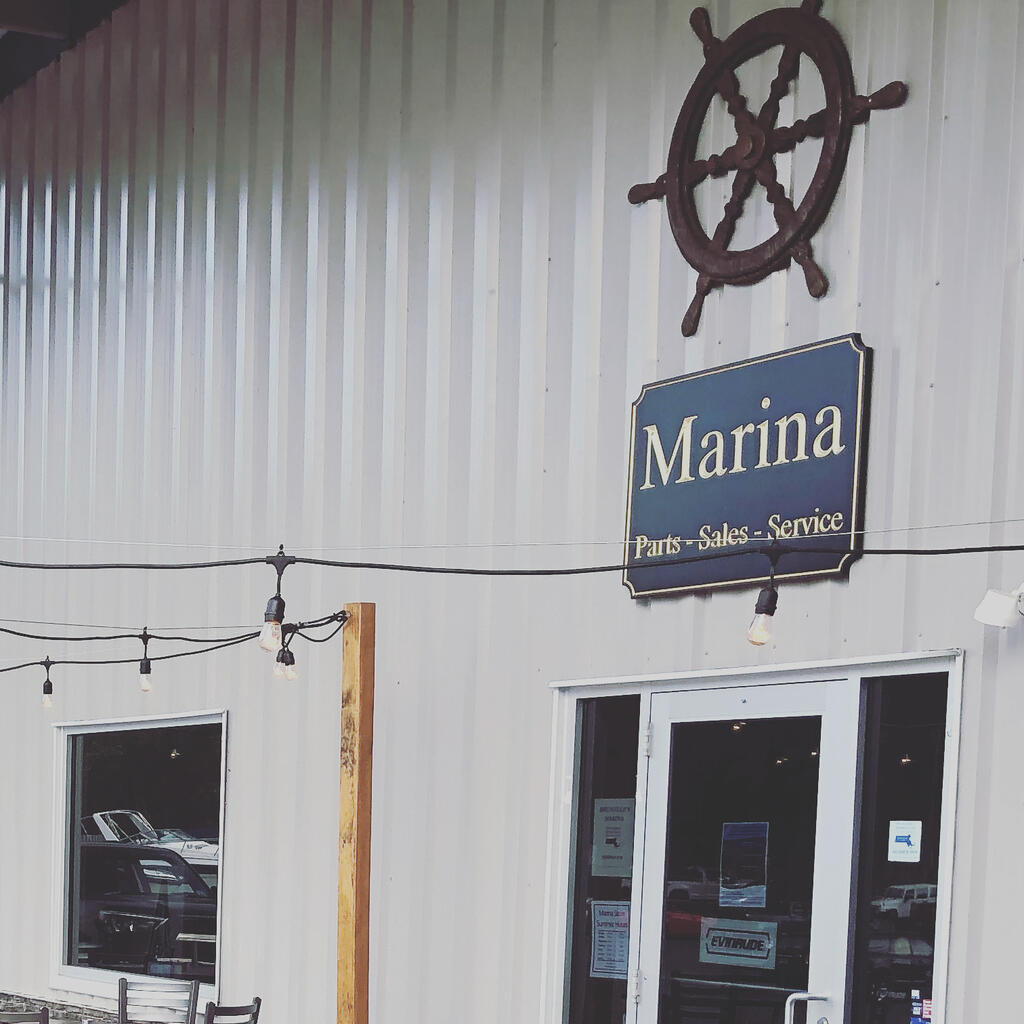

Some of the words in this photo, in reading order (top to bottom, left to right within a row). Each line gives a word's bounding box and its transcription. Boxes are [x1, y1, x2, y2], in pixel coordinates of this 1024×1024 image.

[639, 396, 846, 491] Marina
[633, 533, 681, 560] Parts
[698, 522, 749, 551] Sales
[767, 507, 844, 540] Service
[711, 935, 765, 952] EVINRUDE
